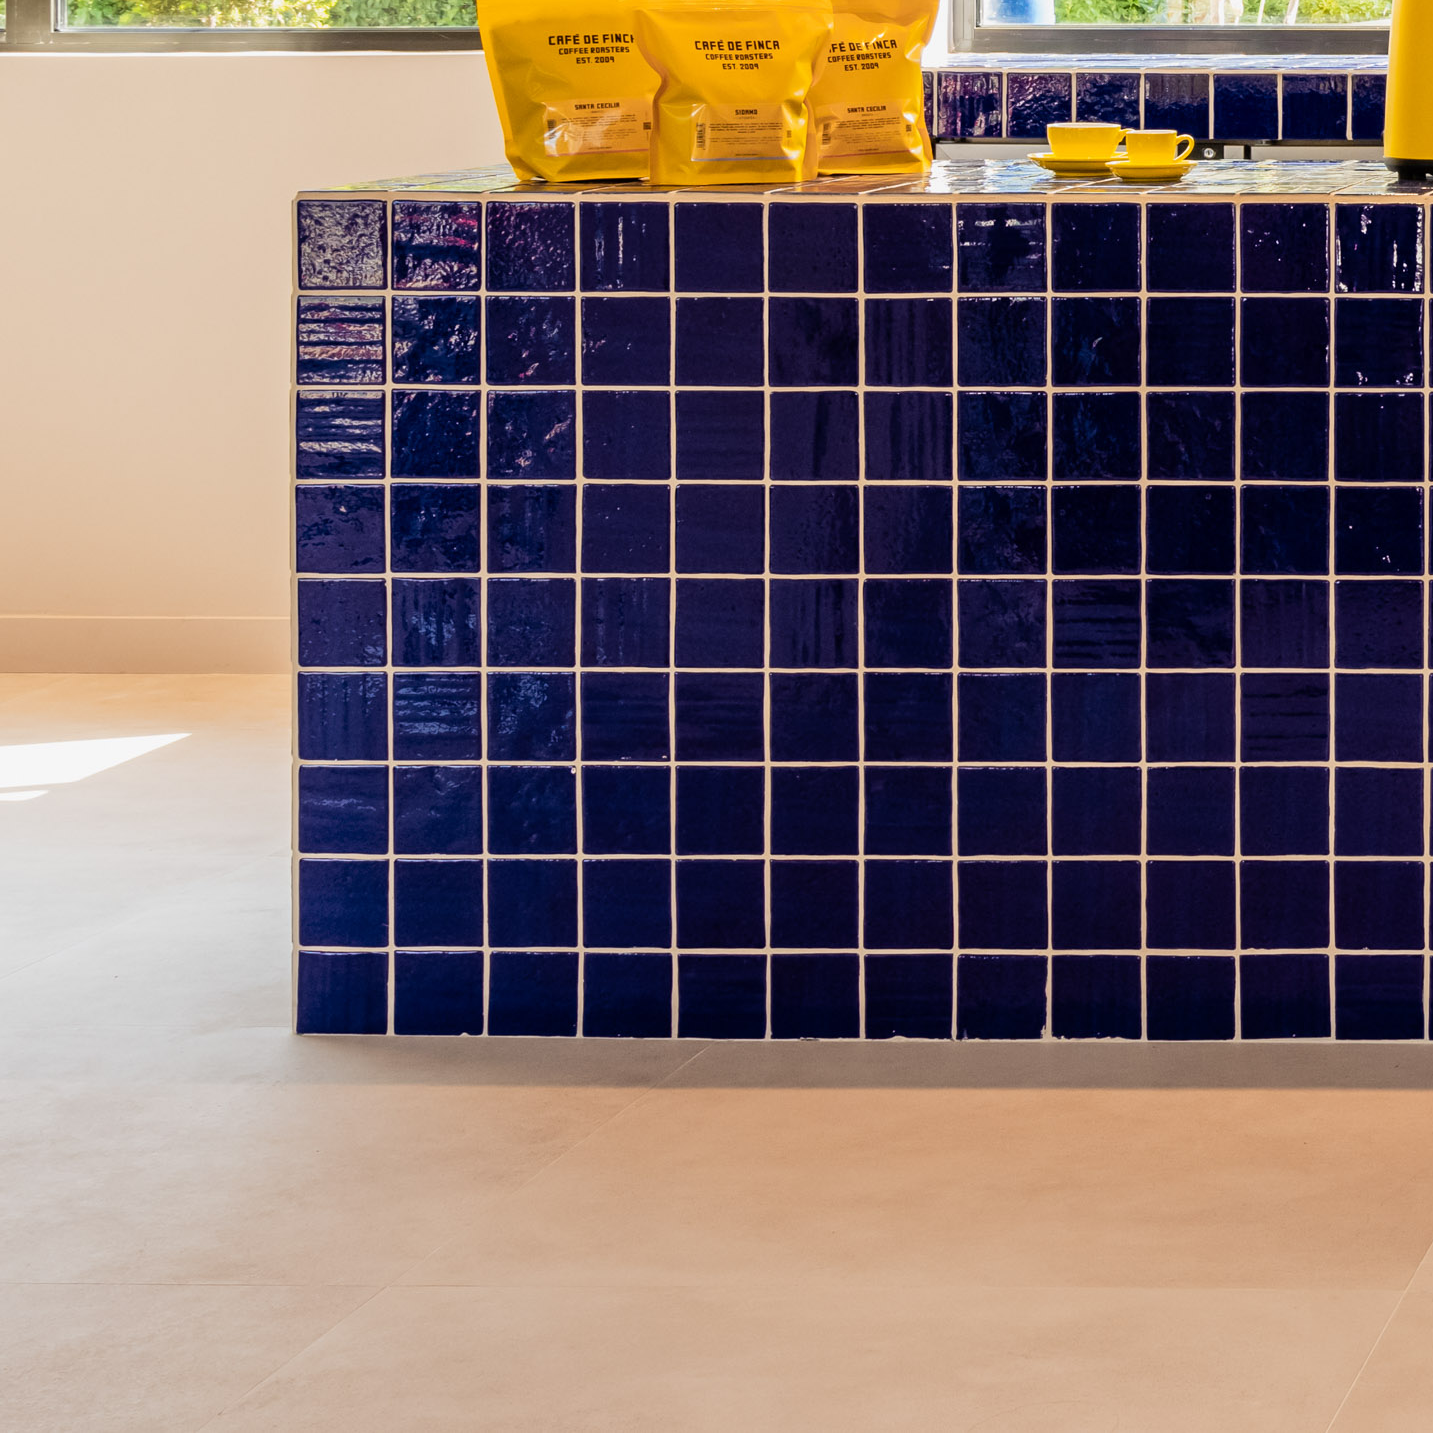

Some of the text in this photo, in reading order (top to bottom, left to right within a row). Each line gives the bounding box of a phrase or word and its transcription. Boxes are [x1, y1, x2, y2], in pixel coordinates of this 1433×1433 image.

[548, 34, 580, 46] CAFÉ
[583, 34, 599, 45] DE
[558, 46, 630, 55] COFFEE ROASTERS
[694, 40, 780, 51] CAFÉ DE FINCA
[829, 39, 898, 53] FÉ DE FINCA
[594, 56, 615, 64] 2009
[705, 53, 733, 61] COFFEE
[827, 52, 892, 63] COFFEE ROASTERS
[861, 62, 879, 70] 2009
